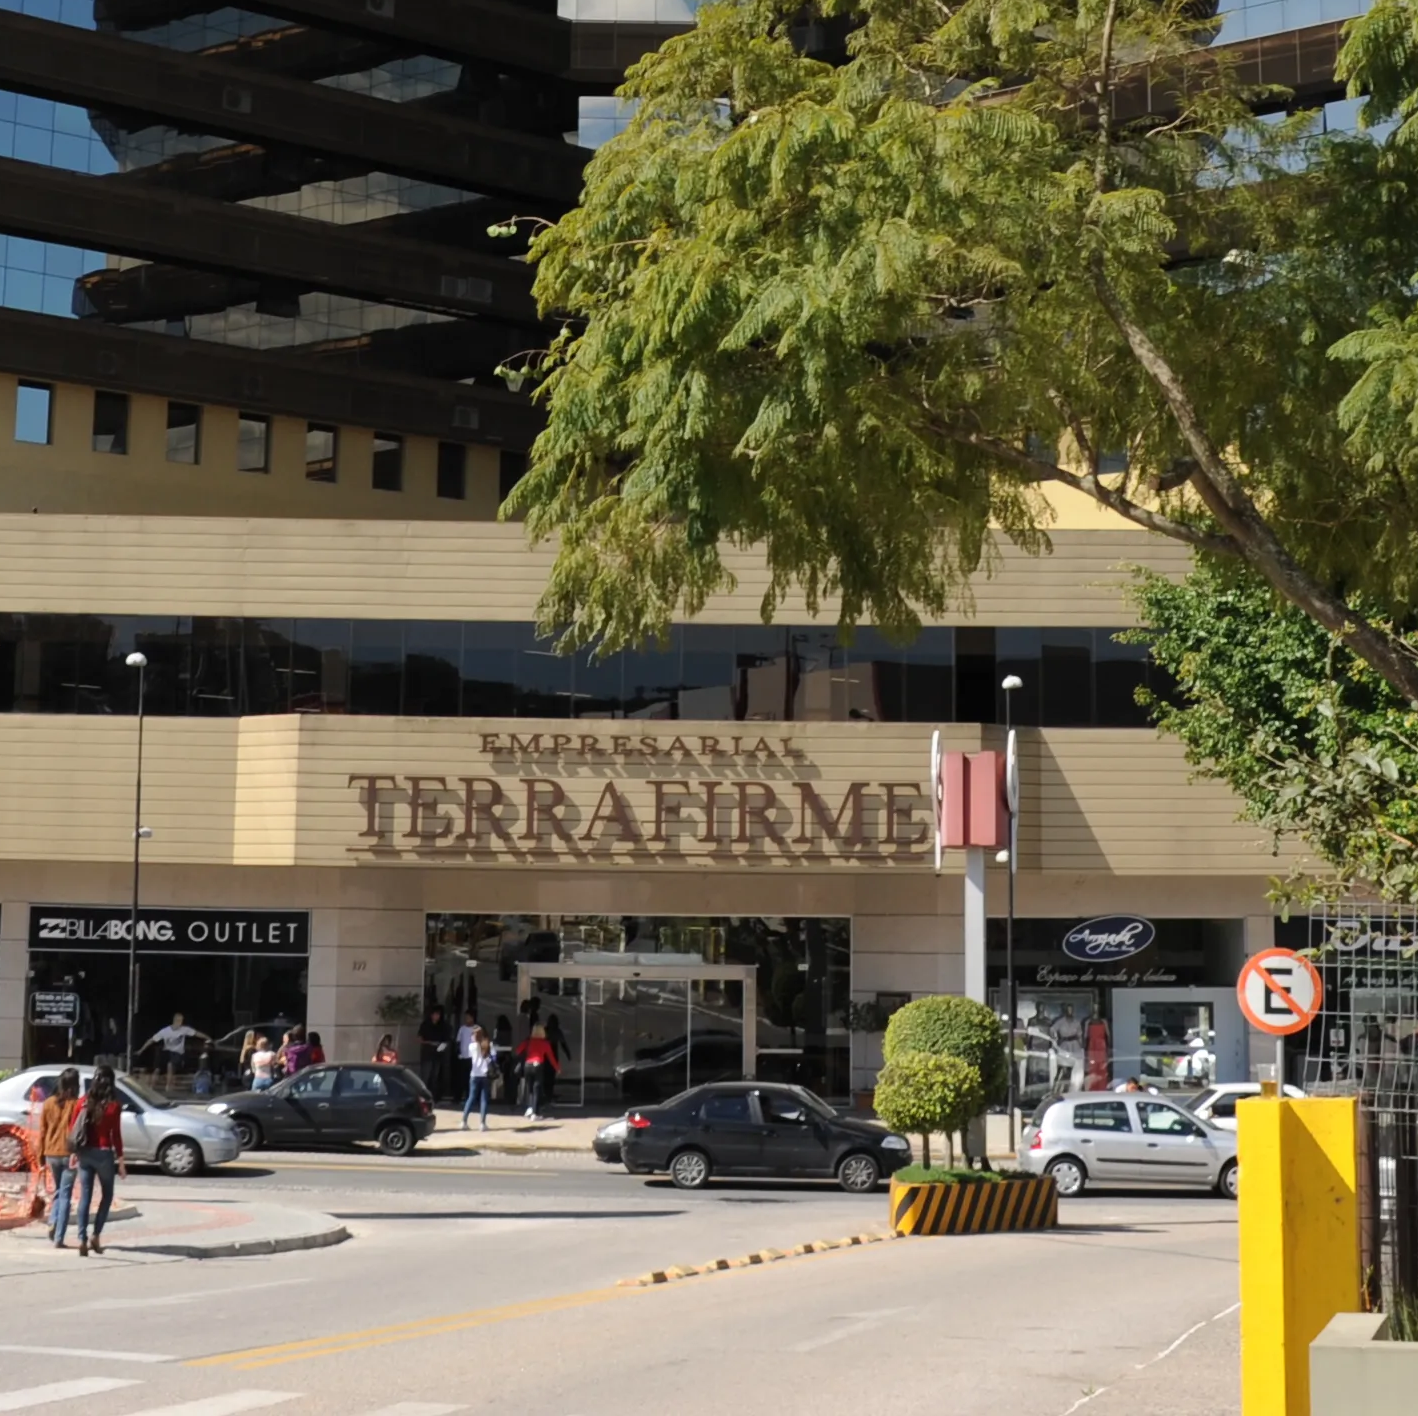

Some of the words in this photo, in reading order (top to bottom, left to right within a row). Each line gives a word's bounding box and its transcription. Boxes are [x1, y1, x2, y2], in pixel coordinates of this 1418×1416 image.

[478, 733, 804, 758] EMPRESARIAL
[347, 773, 931, 846] TERRAFIRME
[187, 920, 299, 943] OUTLET
[1264, 967, 1294, 1015] E
